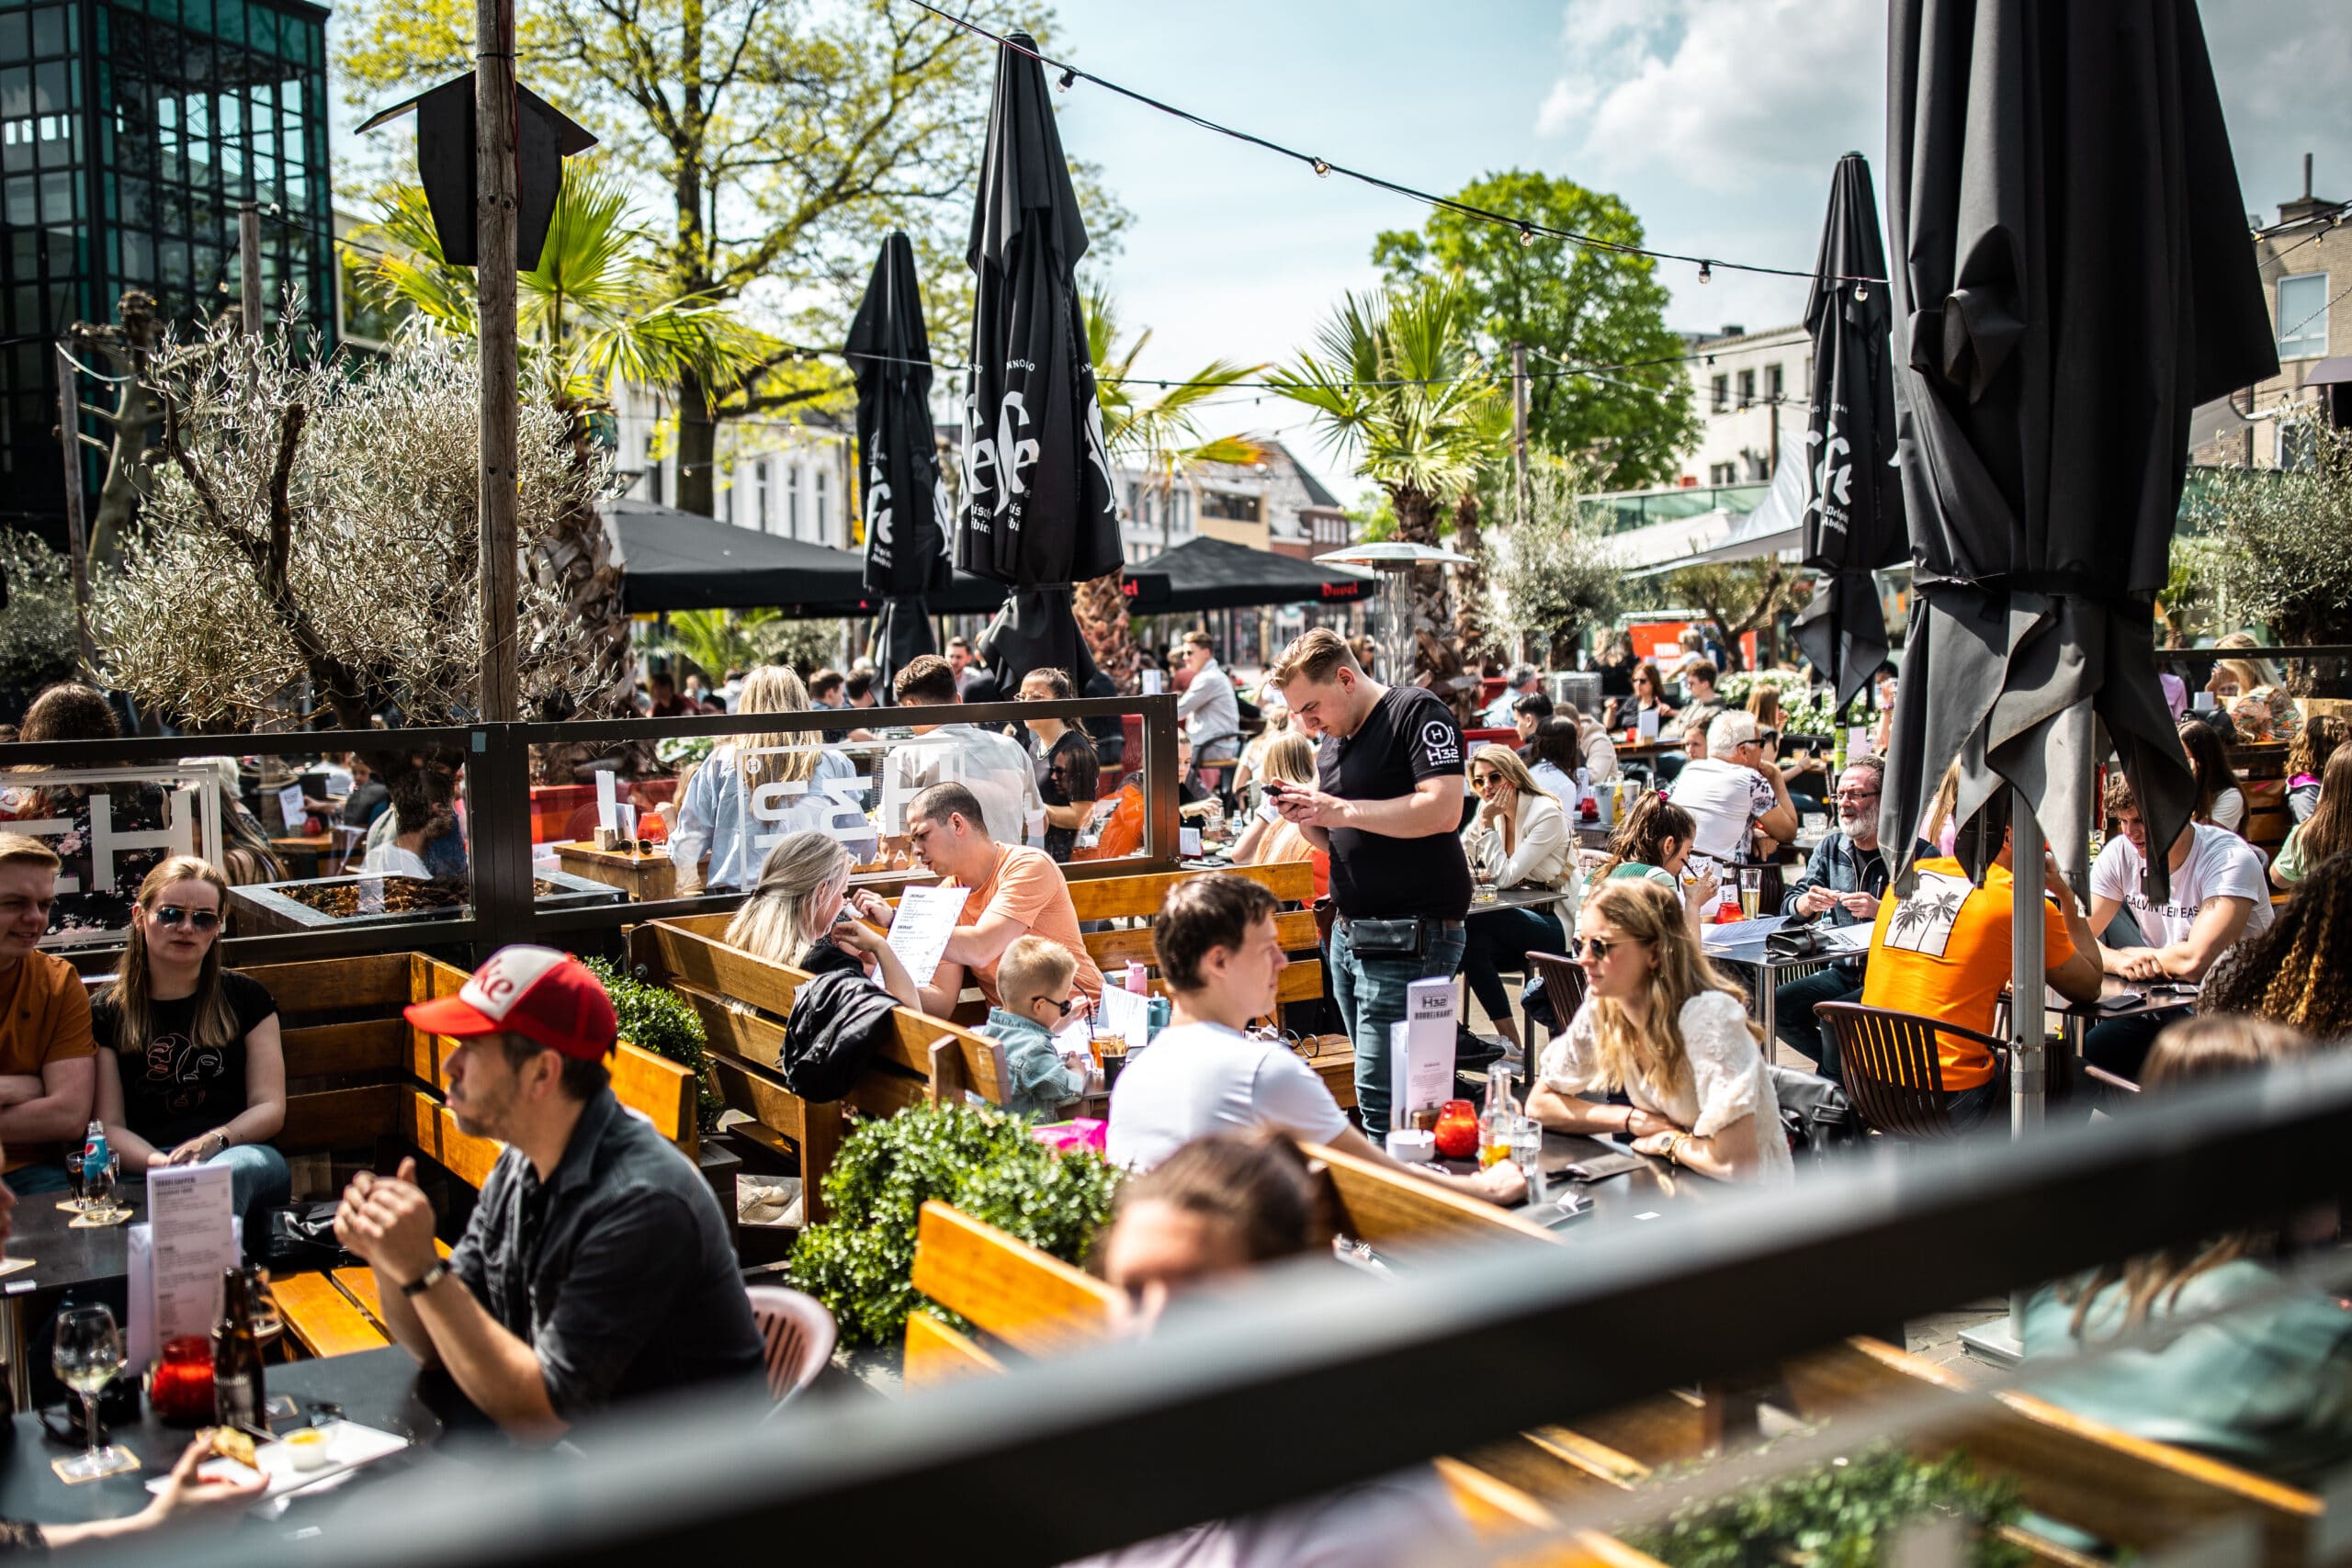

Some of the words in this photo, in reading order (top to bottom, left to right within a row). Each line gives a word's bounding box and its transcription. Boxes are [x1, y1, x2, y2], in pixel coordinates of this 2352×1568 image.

[1321, 580, 1359, 598] Duvel
[1426, 748, 1459, 761] H32
[2125, 894, 2159, 913] CALVIN
[1422, 996, 1447, 1008] H32
